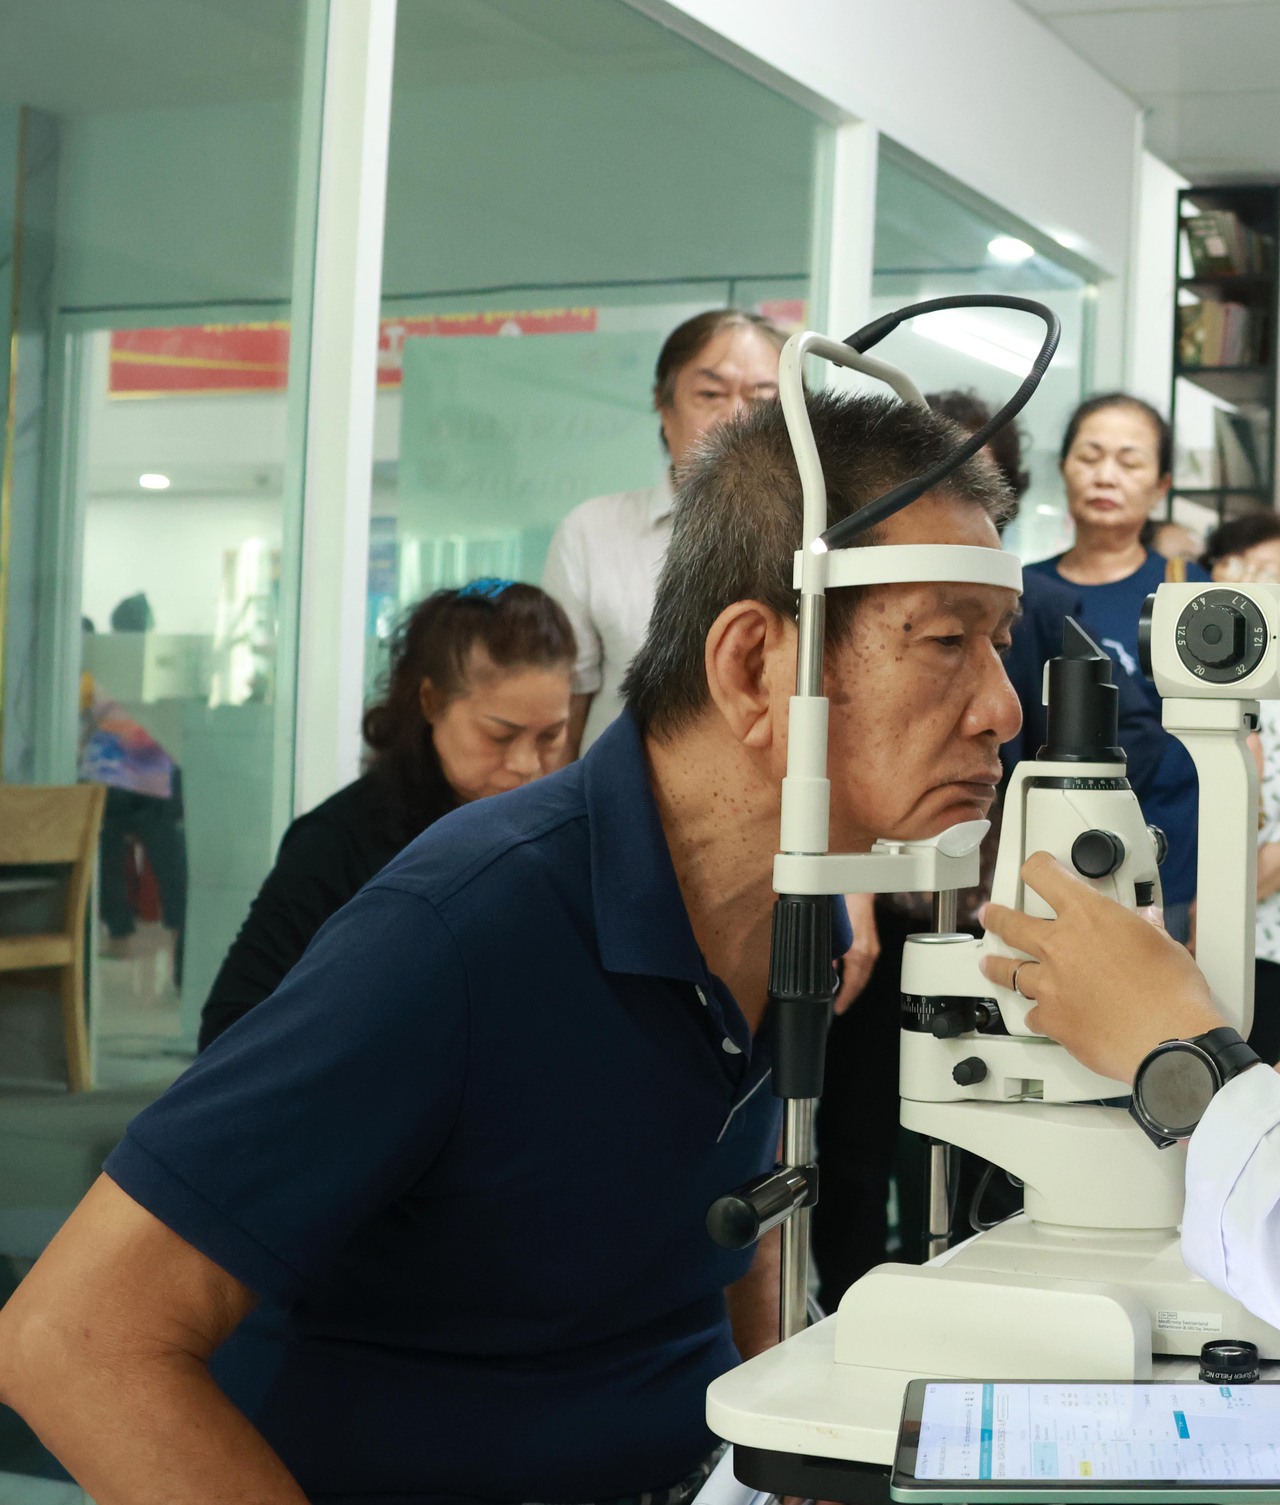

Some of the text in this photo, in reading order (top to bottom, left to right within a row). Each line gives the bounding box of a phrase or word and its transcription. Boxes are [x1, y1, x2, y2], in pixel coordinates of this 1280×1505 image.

[1192, 597, 1206, 610] 4.8
[1232, 595, 1247, 609] 7.7
[1177, 626, 1186, 646] 12.5
[1253, 627, 1263, 647] 12.5
[1194, 664, 1206, 676] 20
[1235, 664, 1247, 675] 32
[1215, 1373, 1233, 1381] FIELD
[1234, 1372, 1252, 1380] SUPER
